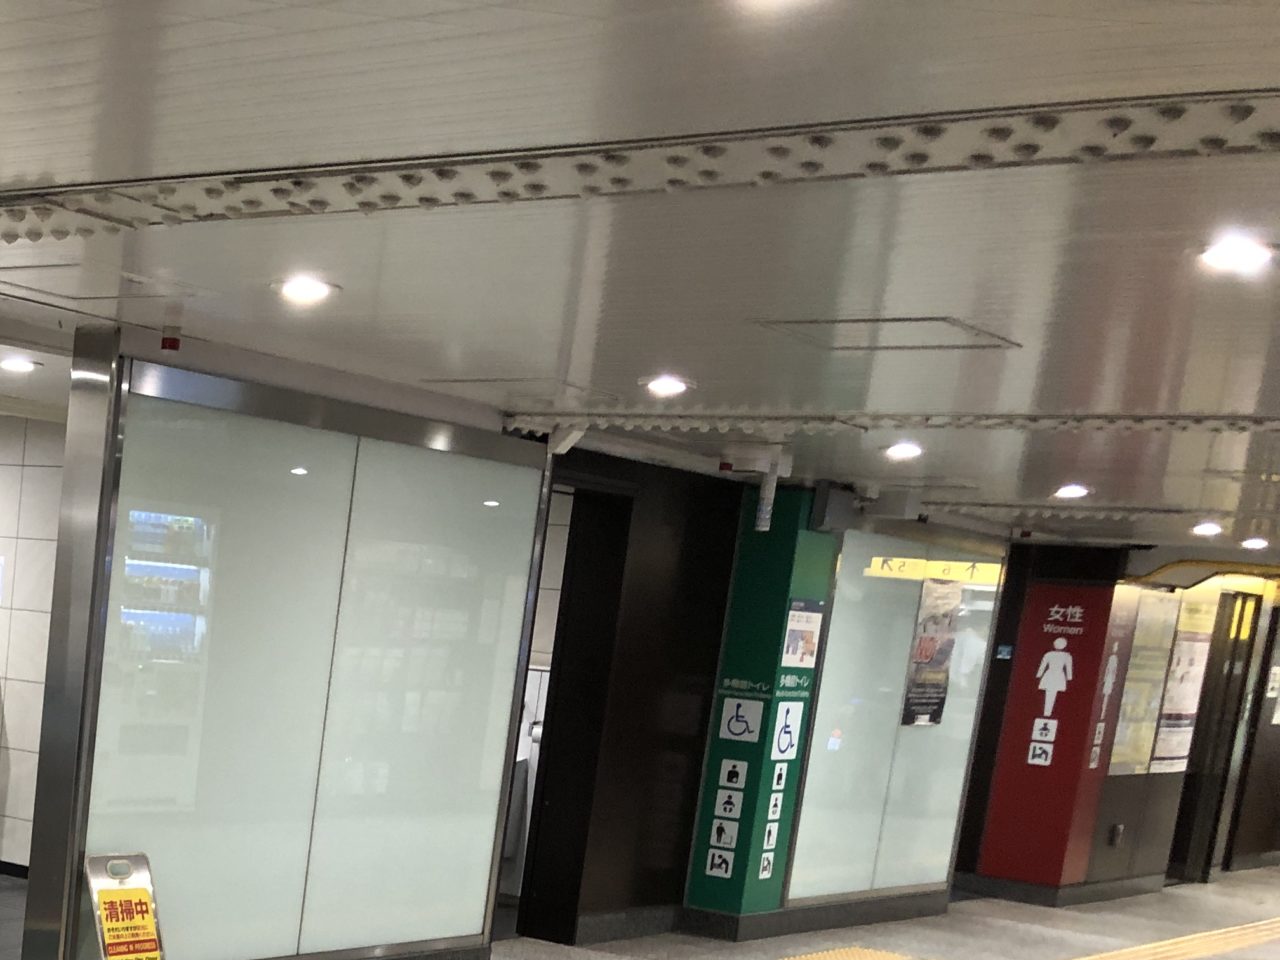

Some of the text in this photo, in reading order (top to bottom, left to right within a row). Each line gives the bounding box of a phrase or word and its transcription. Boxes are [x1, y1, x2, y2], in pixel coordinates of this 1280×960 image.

[1048, 604, 1084, 622] 女性
[103, 898, 149, 923] 清掃中
